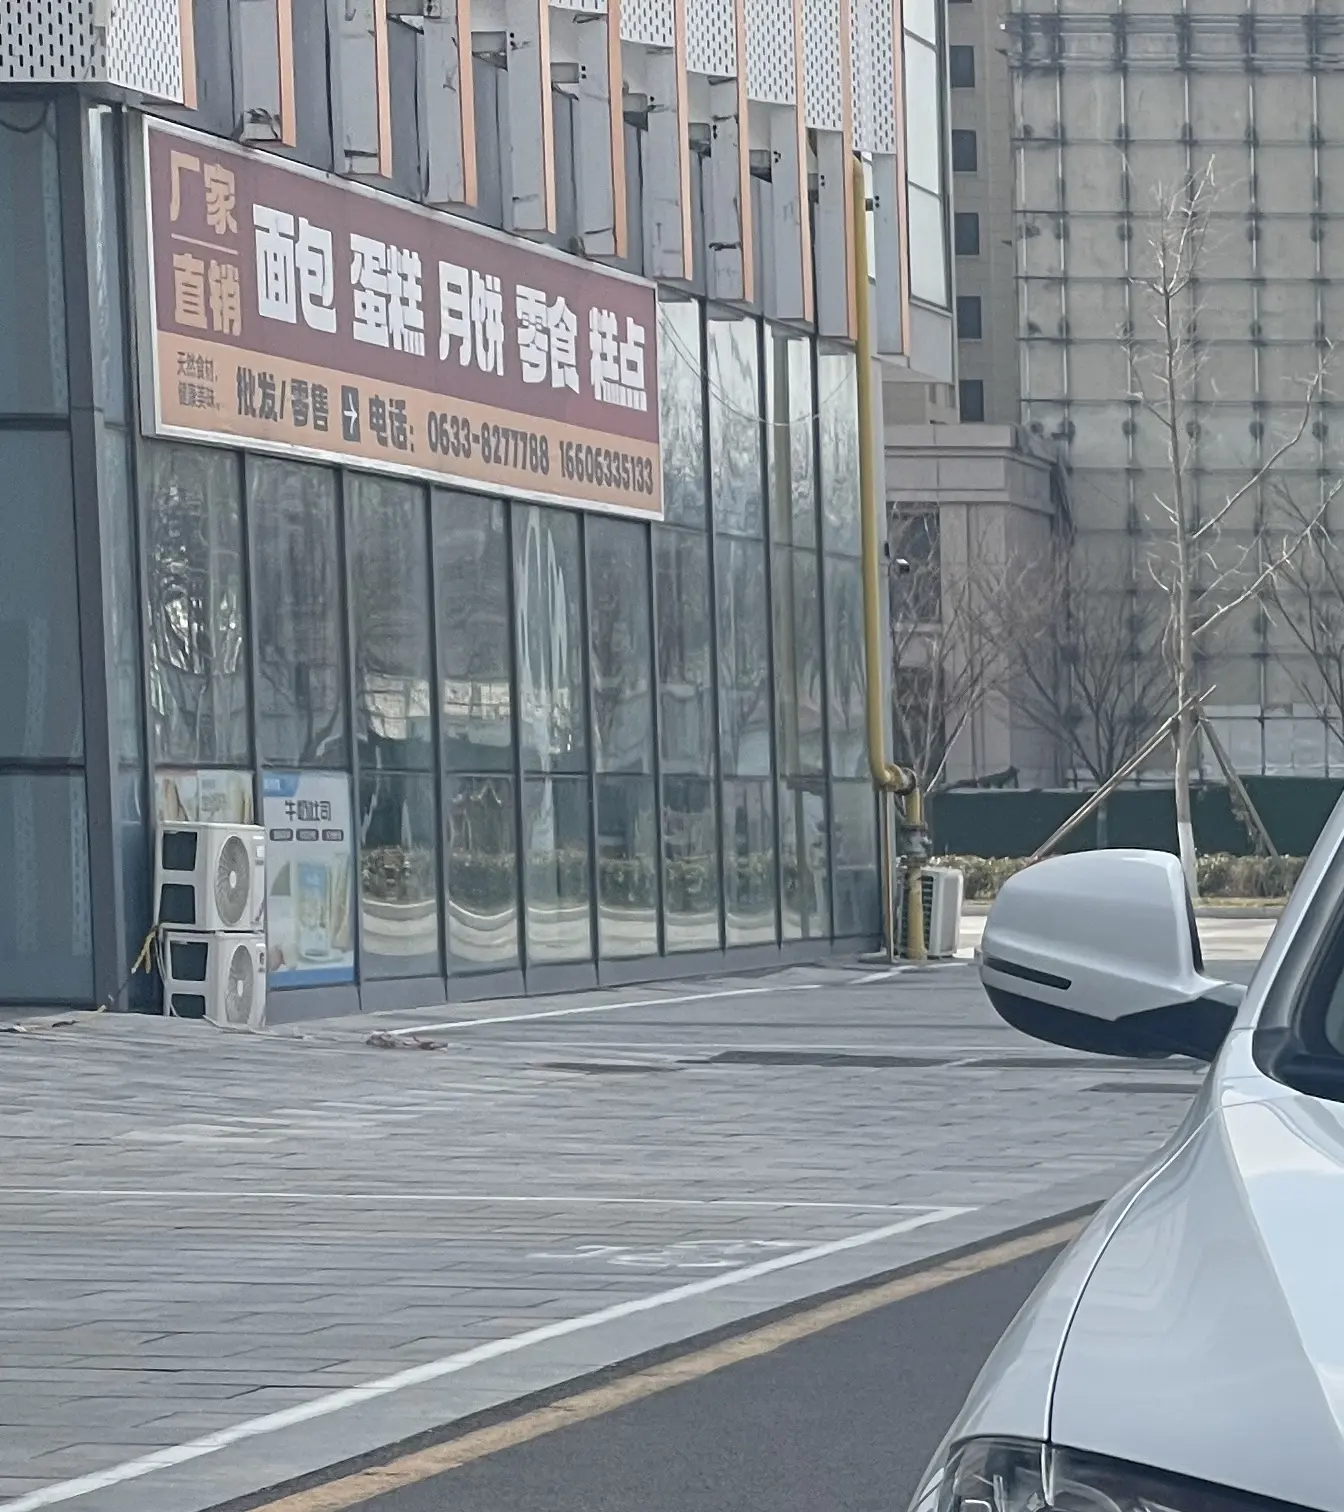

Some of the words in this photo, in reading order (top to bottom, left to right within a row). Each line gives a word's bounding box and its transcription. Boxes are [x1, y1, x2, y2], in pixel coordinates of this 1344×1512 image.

[169, 150, 238, 235] 厂家
[172, 252, 242, 337] 直销
[252, 203, 337, 334] 面包
[349, 234, 426, 357] 蛋糕
[438, 260, 505, 377] 月饼
[515, 284, 580, 395] 零食
[588, 306, 648, 412] 糕点
[236, 365, 329, 432] 批发/零售
[427, 410, 550, 477] 0633-8277788
[559, 440, 654, 496] 16606335133
